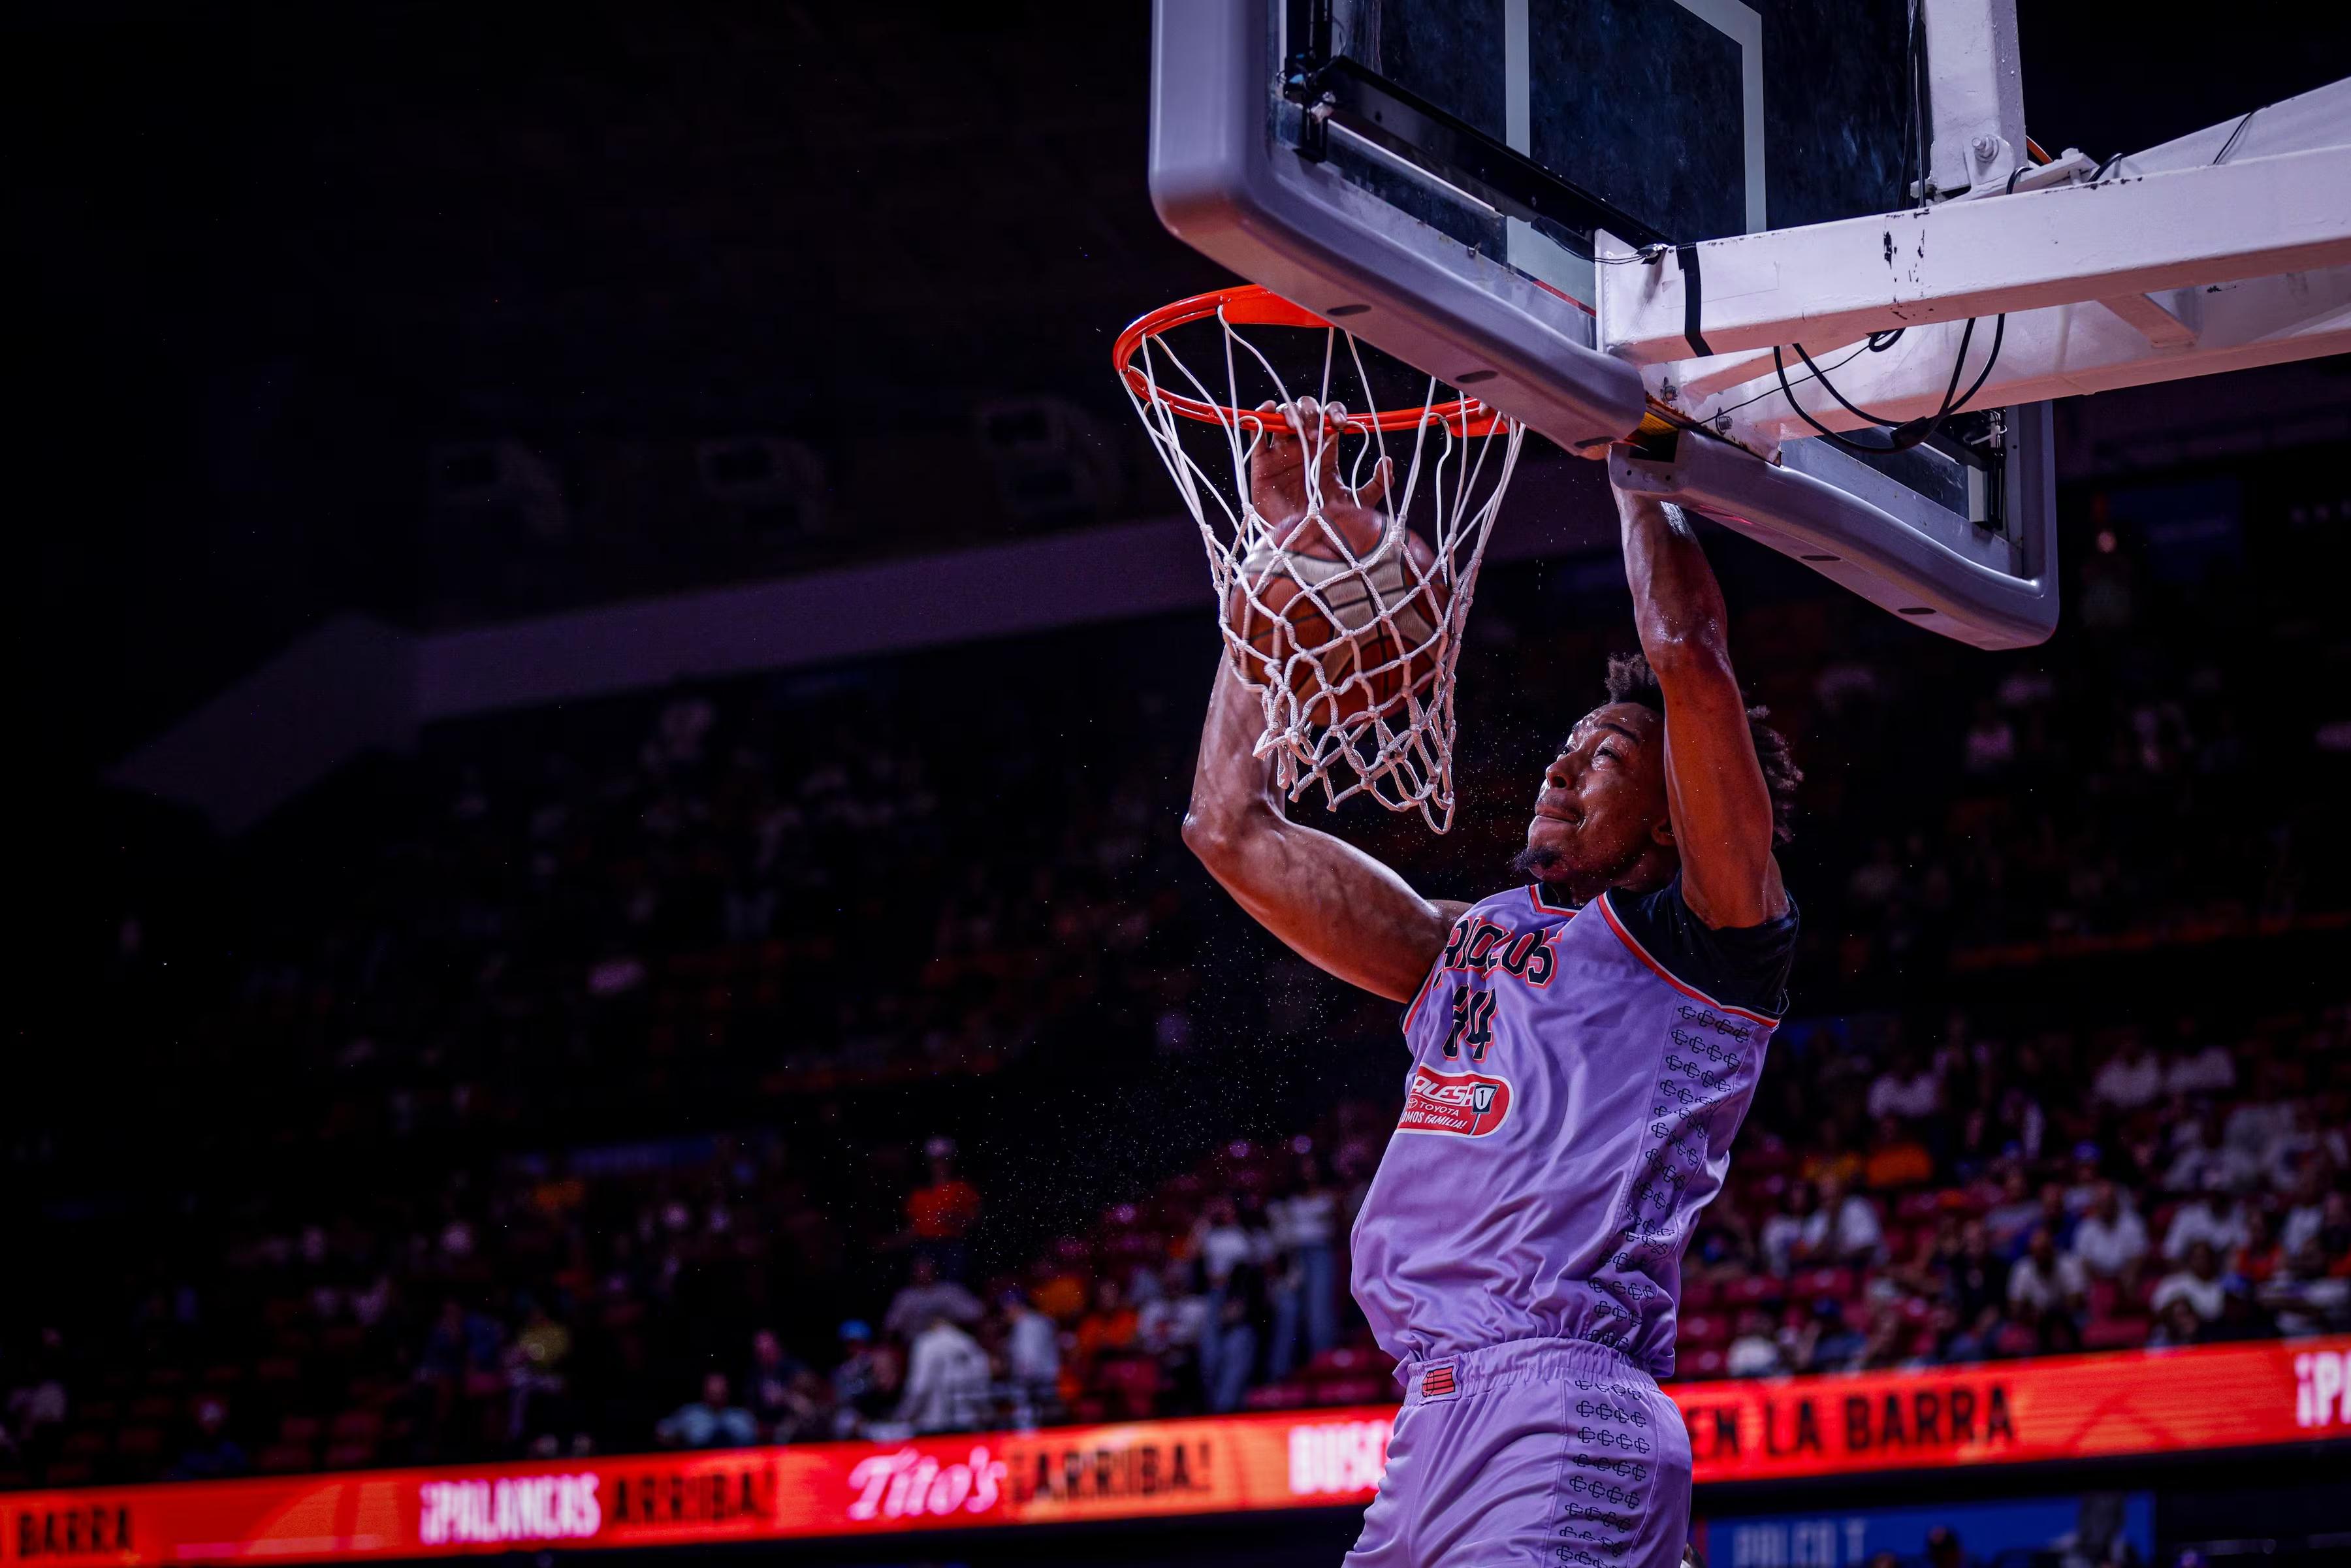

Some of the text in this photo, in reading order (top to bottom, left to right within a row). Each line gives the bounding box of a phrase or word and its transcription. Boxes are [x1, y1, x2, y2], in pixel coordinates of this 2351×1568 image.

[1401, 1111, 1467, 1130] OMOS FAMILIA!
[1420, 1101, 1459, 1117] TOYOTA
[1767, 1399, 1820, 1456] LA
[1844, 1385, 2014, 1452] BARRA
[848, 1445, 1007, 1520] Tito's
[18, 1504, 129, 1560] BARRA
